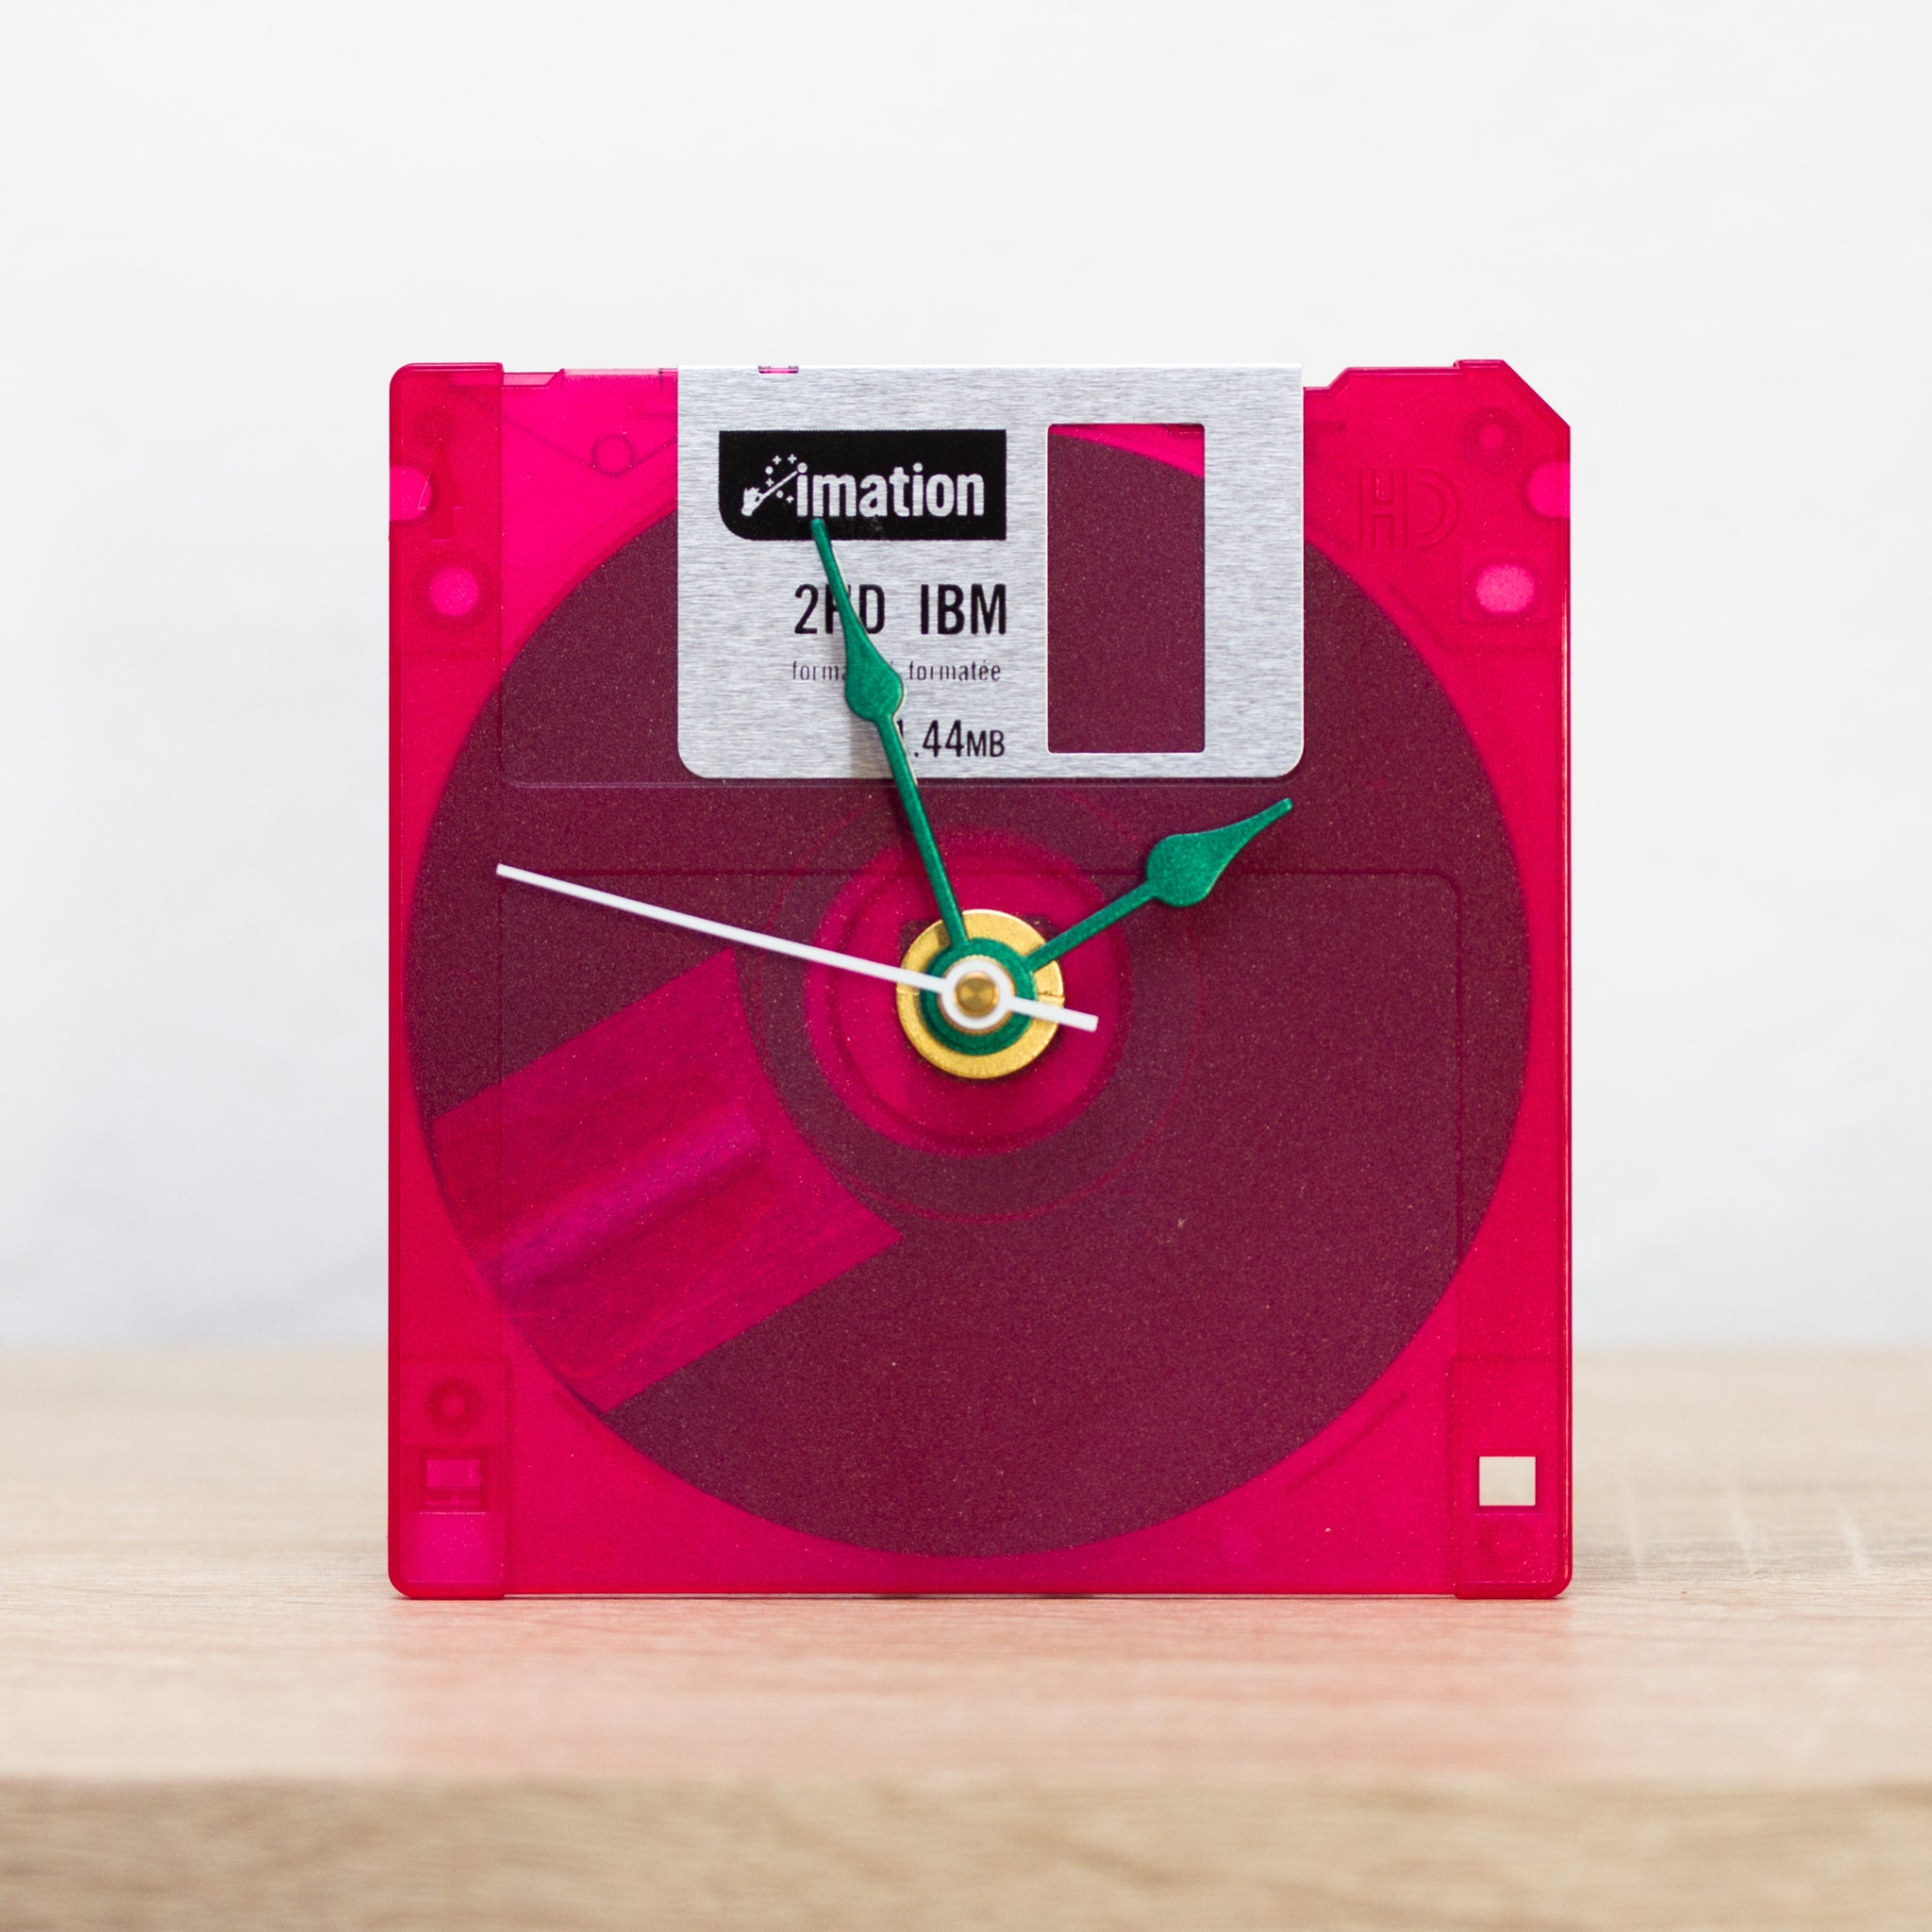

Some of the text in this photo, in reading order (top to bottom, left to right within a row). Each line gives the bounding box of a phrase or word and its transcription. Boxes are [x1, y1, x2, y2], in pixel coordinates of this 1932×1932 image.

[796, 462, 985, 517] imation
[1357, 466, 1460, 549] HD
[921, 583, 1007, 635] IBM
[908, 659, 1001, 681] formatée
